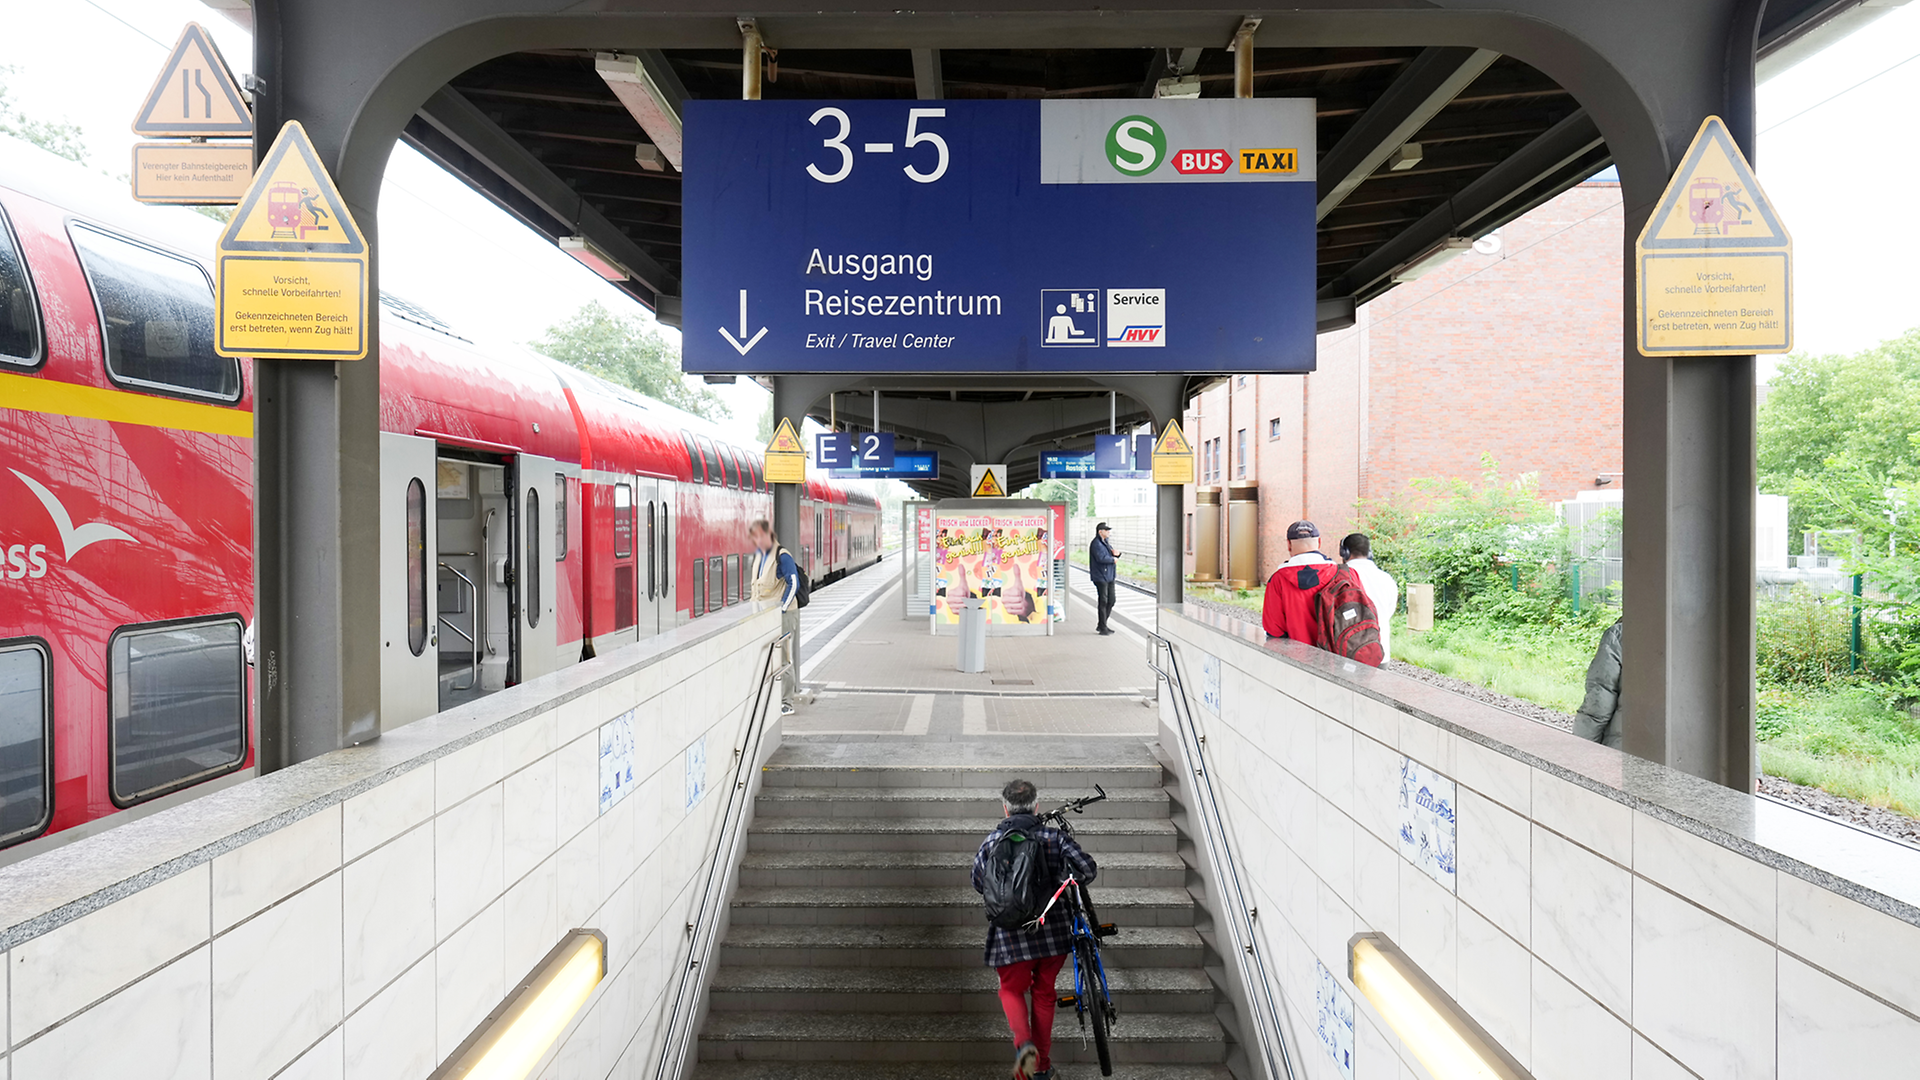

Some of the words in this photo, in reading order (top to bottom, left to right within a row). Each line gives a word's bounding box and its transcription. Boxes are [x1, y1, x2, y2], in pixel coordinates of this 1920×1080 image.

[805, 106, 950, 184] 3-5
[1115, 120, 1157, 172] S
[1181, 152, 1224, 170] BUS
[1242, 152, 1293, 170] TAXI
[142, 162, 180, 172] Verengter
[181, 162, 248, 172] Bahnsteigbereich
[805, 248, 933, 282] Ausgang
[273, 276, 310, 286] Vorsicht,
[1696, 272, 1734, 281] Vorsicht,
[242, 288, 279, 296] schnelle
[280, 288, 342, 298] Vorbeifahrten!
[1665, 285, 1702, 294] schnelle
[1704, 284, 1766, 293] Vorbeifahrten!
[804, 289, 1002, 316] Reisezentrum
[1113, 293, 1160, 305] Service
[235, 311, 314, 322] Gekennzeichneten
[316, 313, 348, 322] Bereich
[1658, 308, 1738, 318] Gekennzeichneten
[1740, 308, 1774, 317] Bereich
[230, 324, 247, 332] erst
[248, 324, 287, 334] betreten,
[314, 326, 331, 336] Zug
[333, 326, 353, 335] hält!
[1652, 322, 1670, 330] erst
[1672, 321, 1711, 330] betreten,
[1739, 321, 1757, 331] Zug
[1758, 320, 1778, 329] hält!
[805, 334, 836, 348] Exit
[838, 334, 848, 348] /
[852, 334, 898, 348] Travel
[902, 333, 955, 348] Center
[1126, 330, 1160, 341] HVV
[820, 436, 838, 463] E
[864, 434, 880, 460] 2
[1114, 438, 1126, 464] 1
[997, 532, 1038, 548] Einfach
[0, 544, 47, 579] ss
